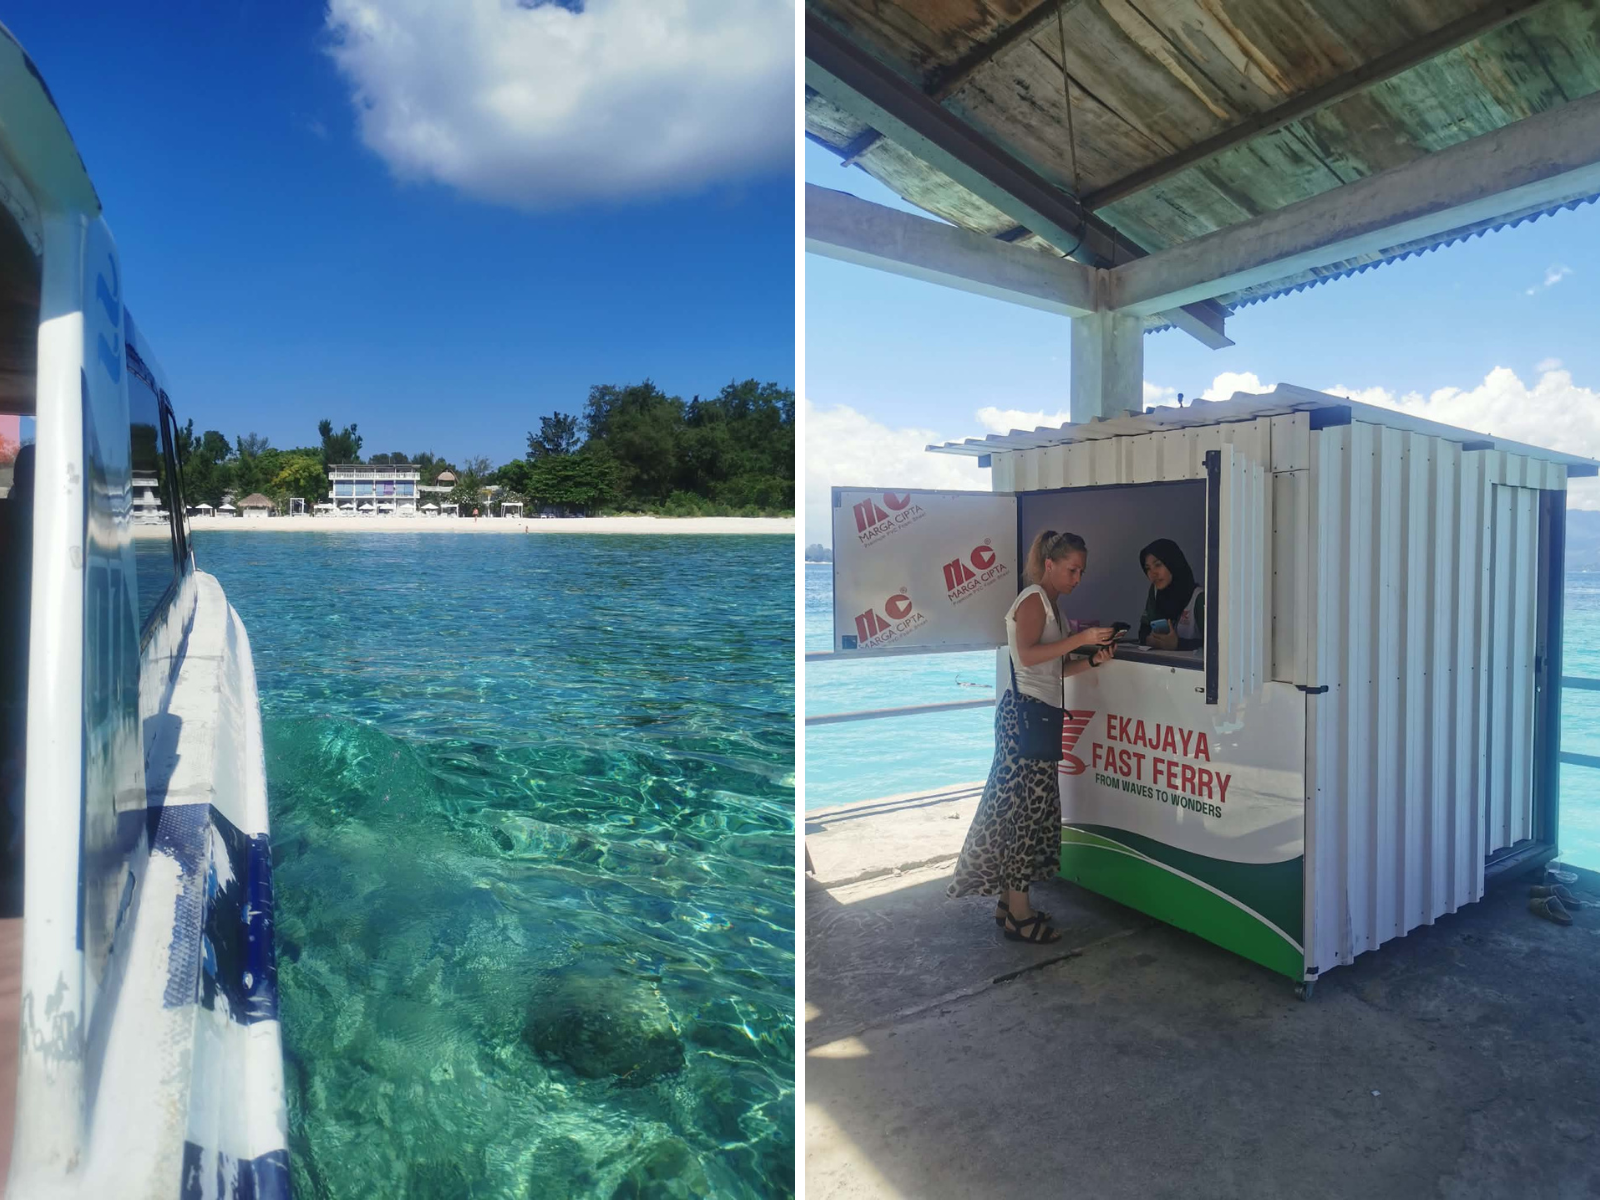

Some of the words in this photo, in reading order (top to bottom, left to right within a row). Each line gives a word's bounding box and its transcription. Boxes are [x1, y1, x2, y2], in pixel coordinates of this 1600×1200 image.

[858, 520, 895, 543] MARGA
[894, 505, 923, 523] CIPTA
[948, 579, 981, 601] MARGA
[981, 563, 1007, 581] CIPTA
[896, 612, 925, 632] CIPTA
[1107, 714, 1210, 762] EKAJAYA
[1092, 742, 1146, 780] FAST
[1153, 757, 1231, 803] FERRY
[1095, 773, 1120, 789] FROM
[1121, 780, 1154, 799] WAVES
[1155, 788, 1169, 803] TO
[1170, 793, 1222, 818] WONDERS
